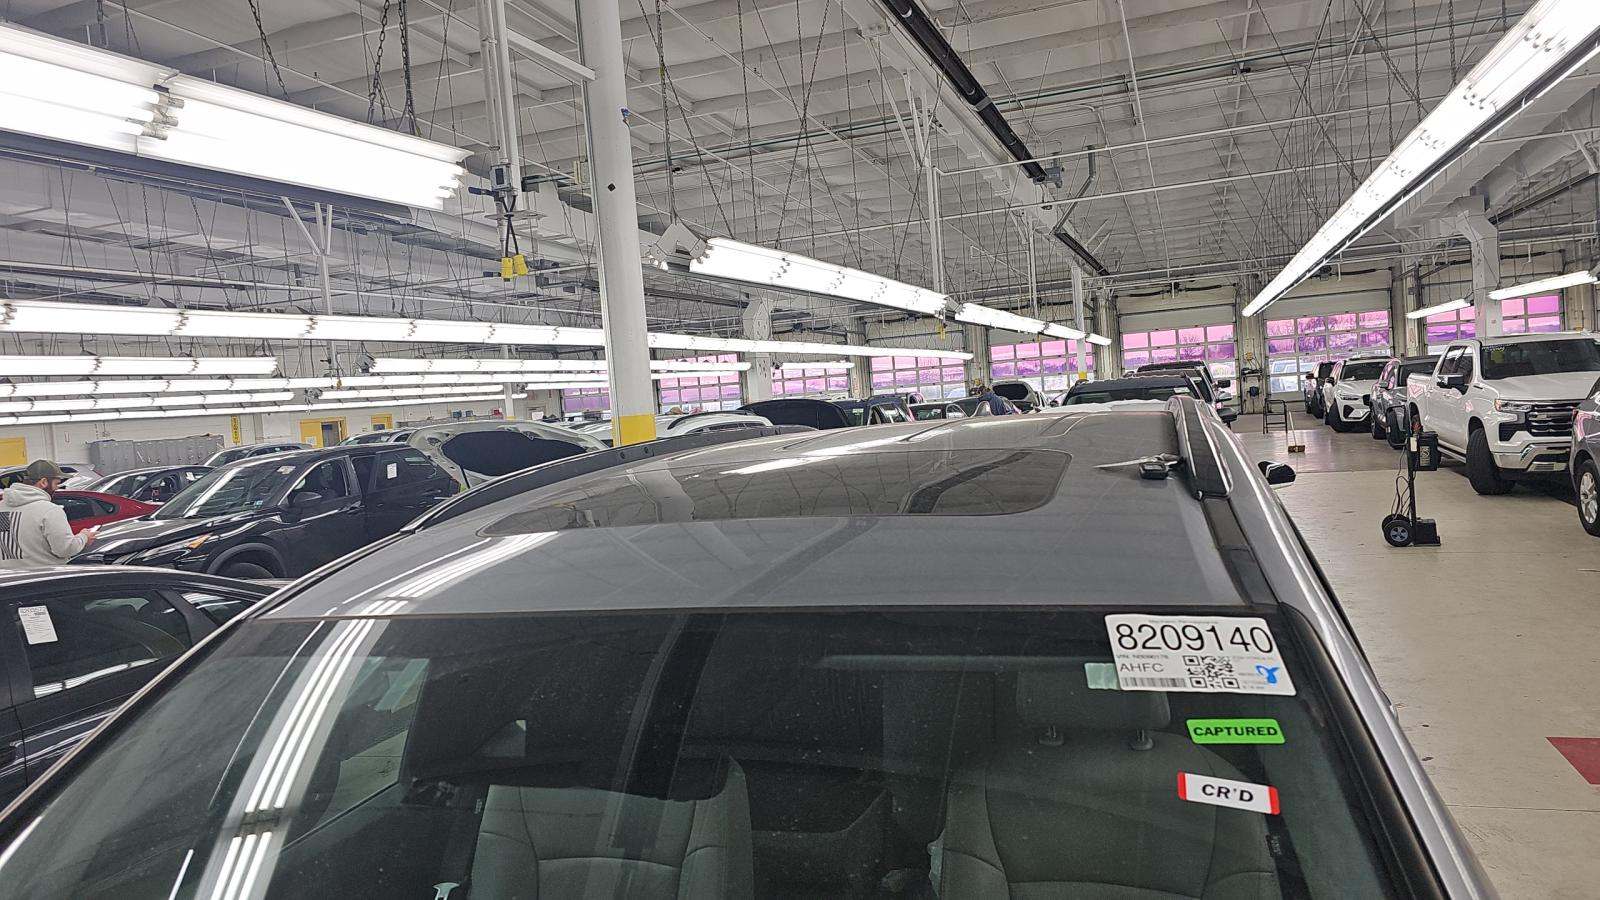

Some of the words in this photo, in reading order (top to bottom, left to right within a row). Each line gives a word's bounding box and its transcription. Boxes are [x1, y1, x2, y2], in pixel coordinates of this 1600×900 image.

[1115, 623, 1273, 653] 8209140
[1120, 662, 1165, 673] AHFC
[1193, 726, 1278, 736] CAPTURED
[1202, 784, 1254, 802] CR'D
